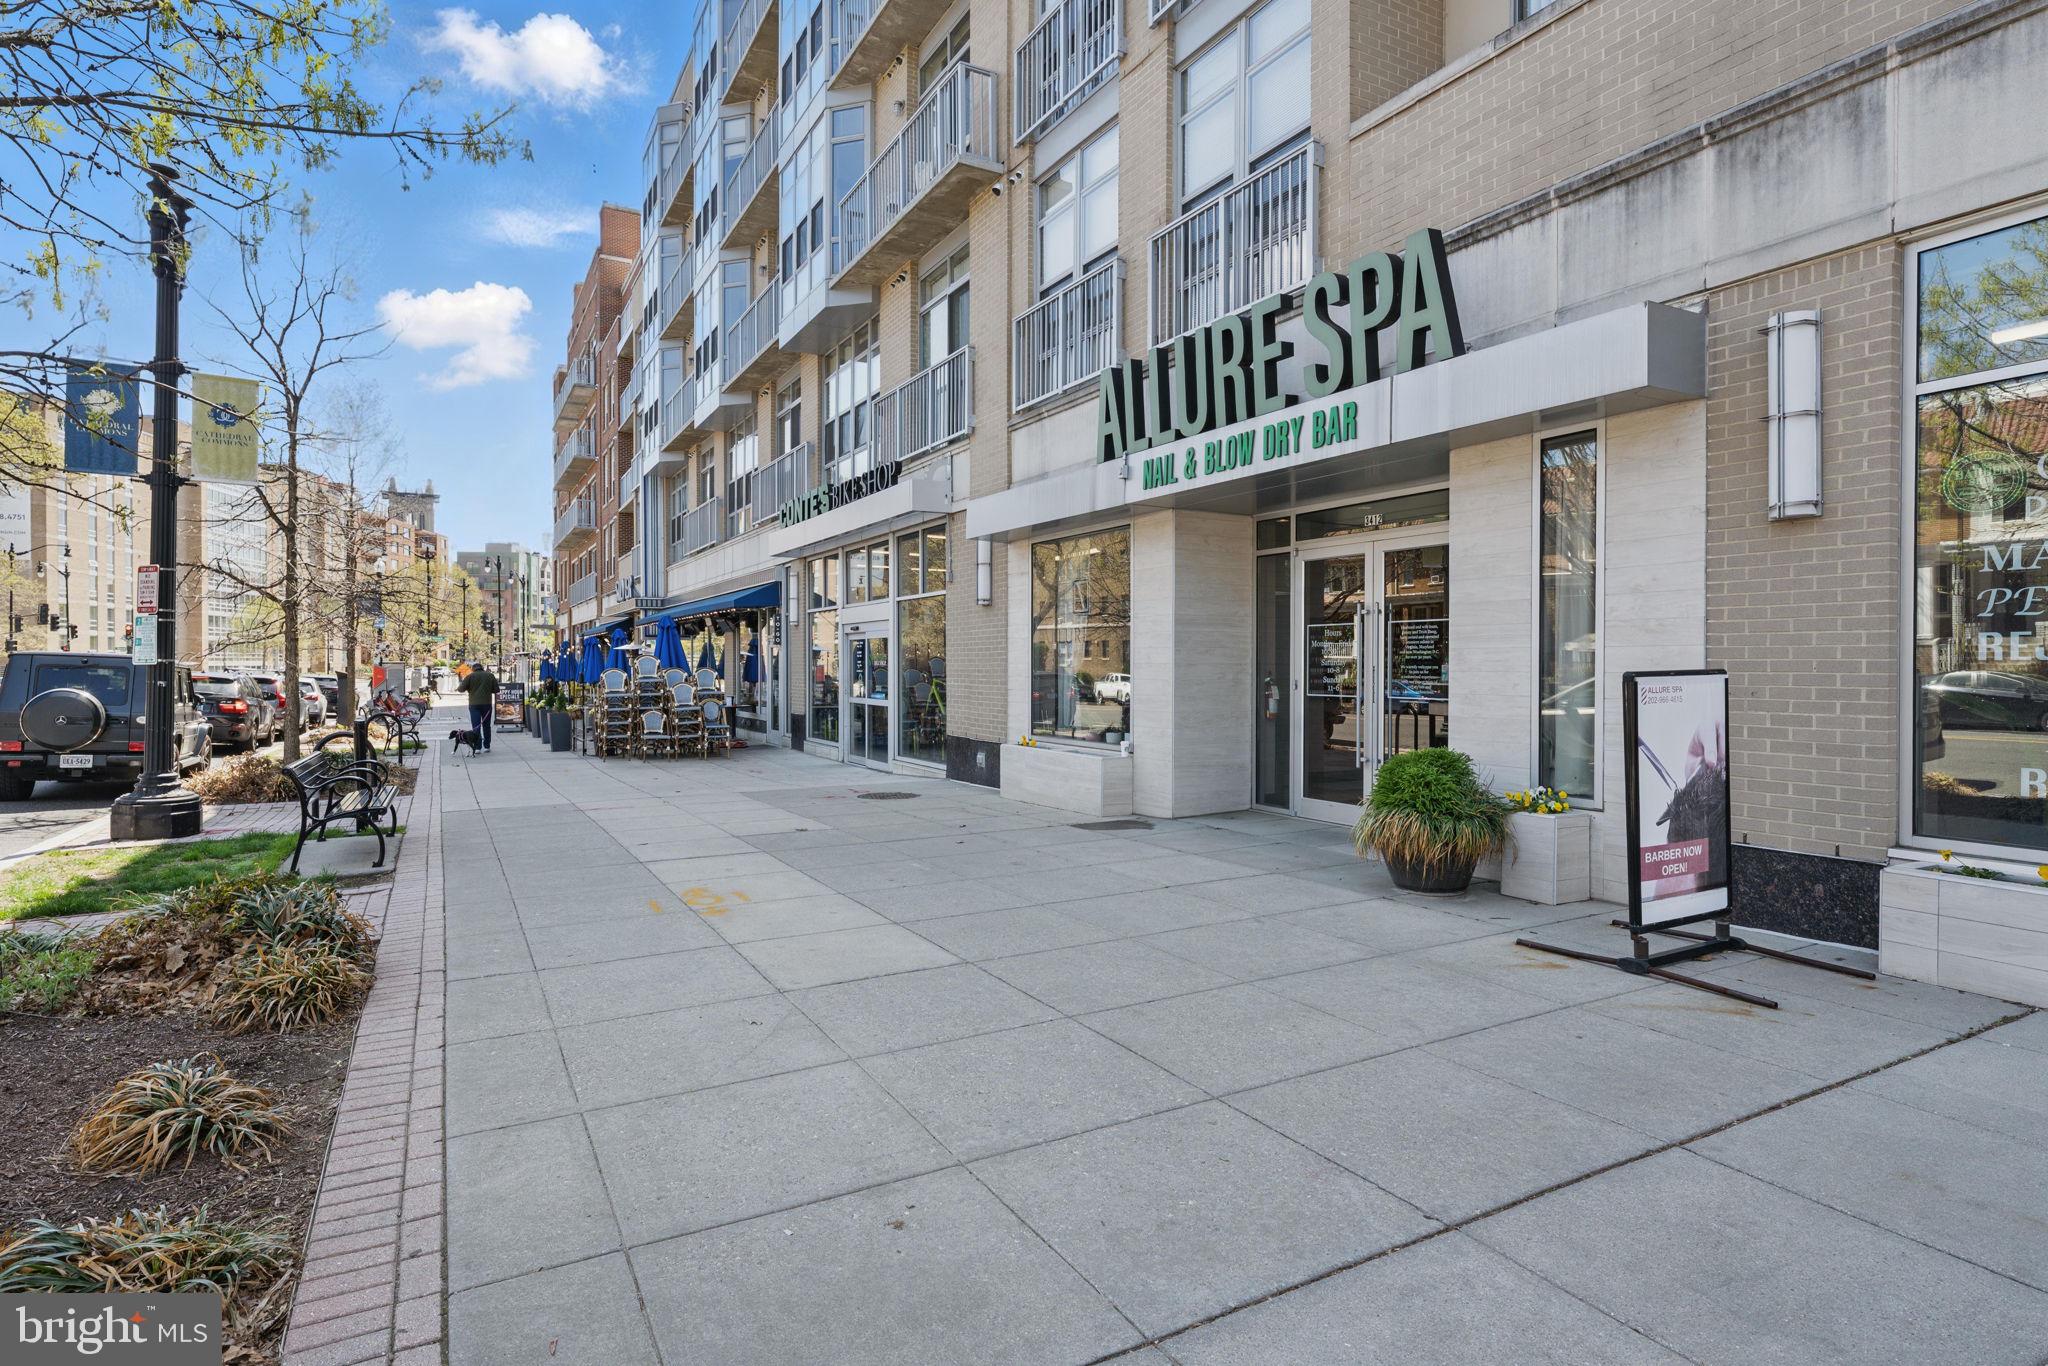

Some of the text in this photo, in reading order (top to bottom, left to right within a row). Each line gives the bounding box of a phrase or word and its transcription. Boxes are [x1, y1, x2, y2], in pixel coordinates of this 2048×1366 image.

[1097, 228, 1466, 464] ALLURE SPA
[1142, 401, 1357, 490] NAIL & BLOW DRY BAR
[831, 476, 861, 510] BIKE
[860, 460, 898, 497] SHOP
[1324, 629, 1343, 637] Hours
[1320, 658, 1346, 667] Saturday
[1647, 686, 1671, 694] ALLURE
[1644, 845, 1702, 863] BARBER NOW
[1661, 862, 1688, 875] OPEN!
